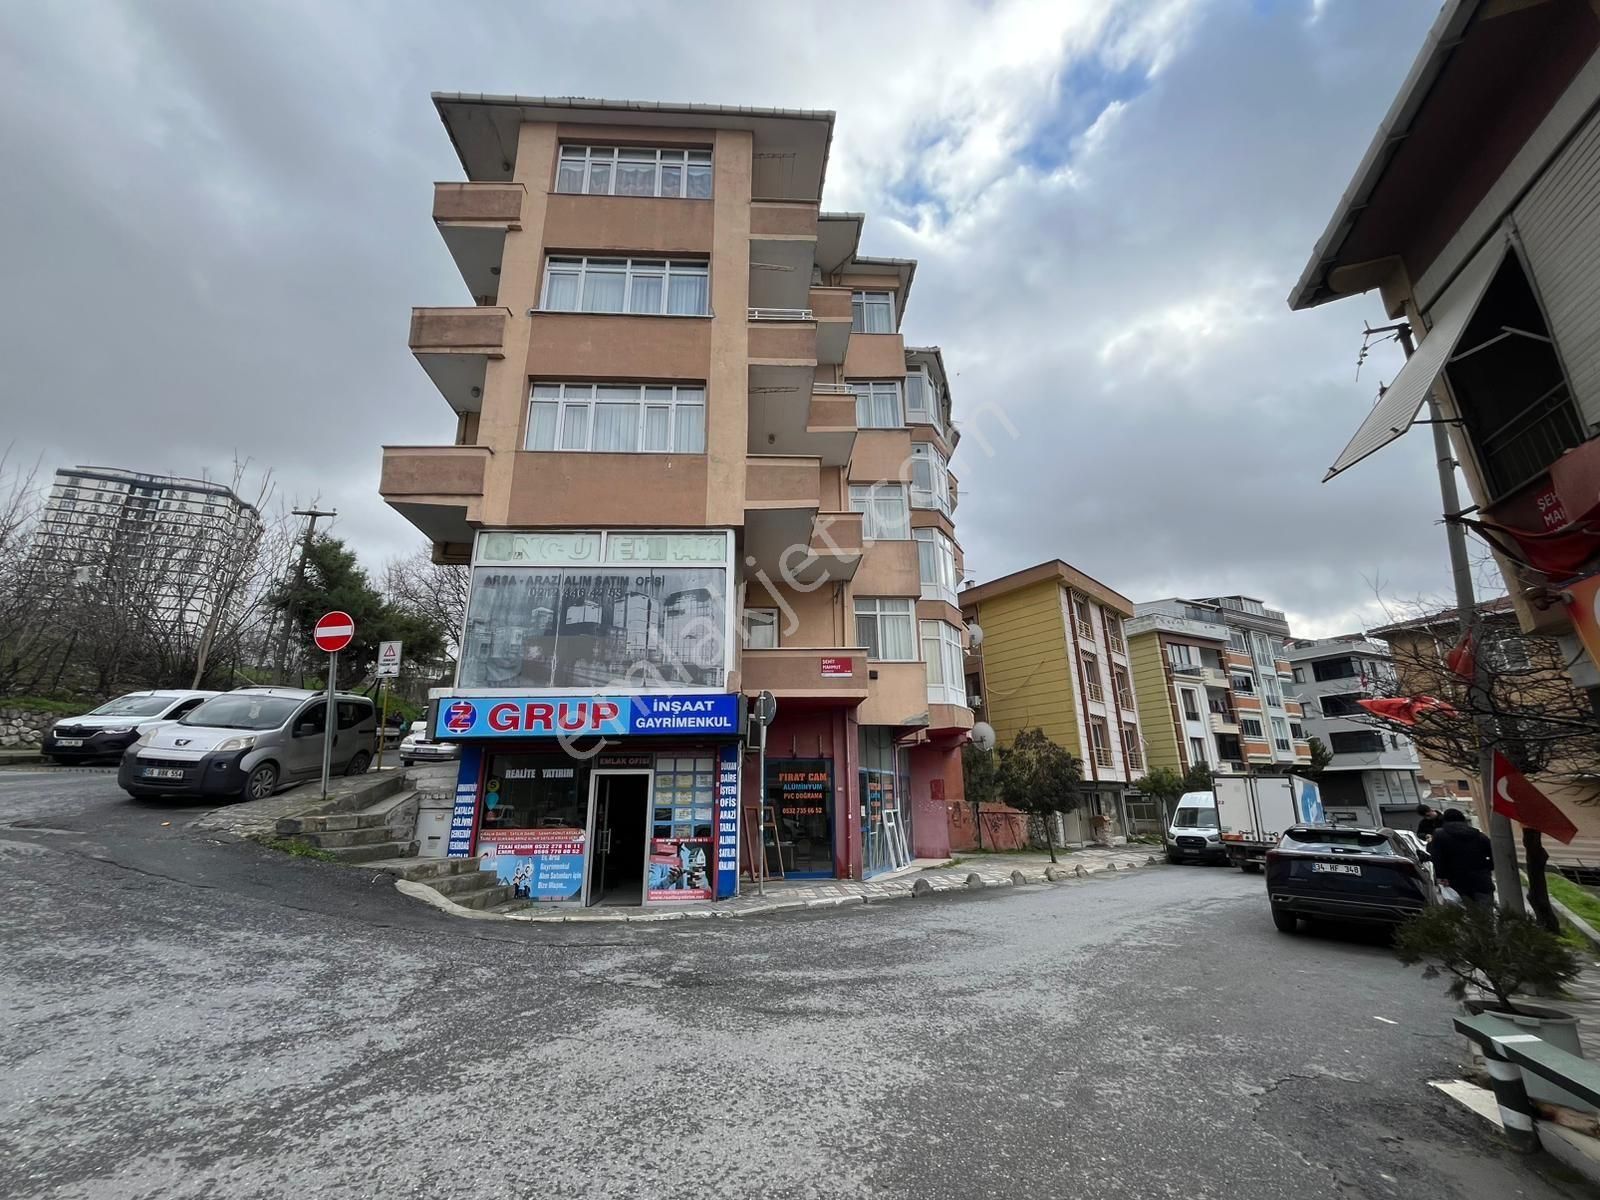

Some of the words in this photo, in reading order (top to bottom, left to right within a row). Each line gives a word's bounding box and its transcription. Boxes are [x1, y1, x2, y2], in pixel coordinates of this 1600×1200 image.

[564, 575, 590, 586] ALIM
[594, 576, 630, 586] SATIM
[653, 699, 715, 713] İNŞAAT
[487, 701, 620, 732] GRUP
[635, 716, 732, 729] GAYRİMENKUL
[600, 757, 627, 765] EMLAK
[505, 768, 536, 779] REALİTE
[542, 768, 574, 778] YATIRIM
[779, 773, 805, 781] FIRAT
[808, 773, 828, 781] CAM
[720, 797, 736, 807] OFİS
[720, 808, 736, 819] ARAZİ
[719, 823, 736, 832] TARLA
[1315, 863, 1325, 871] 34
[1344, 865, 1359, 874] 348
